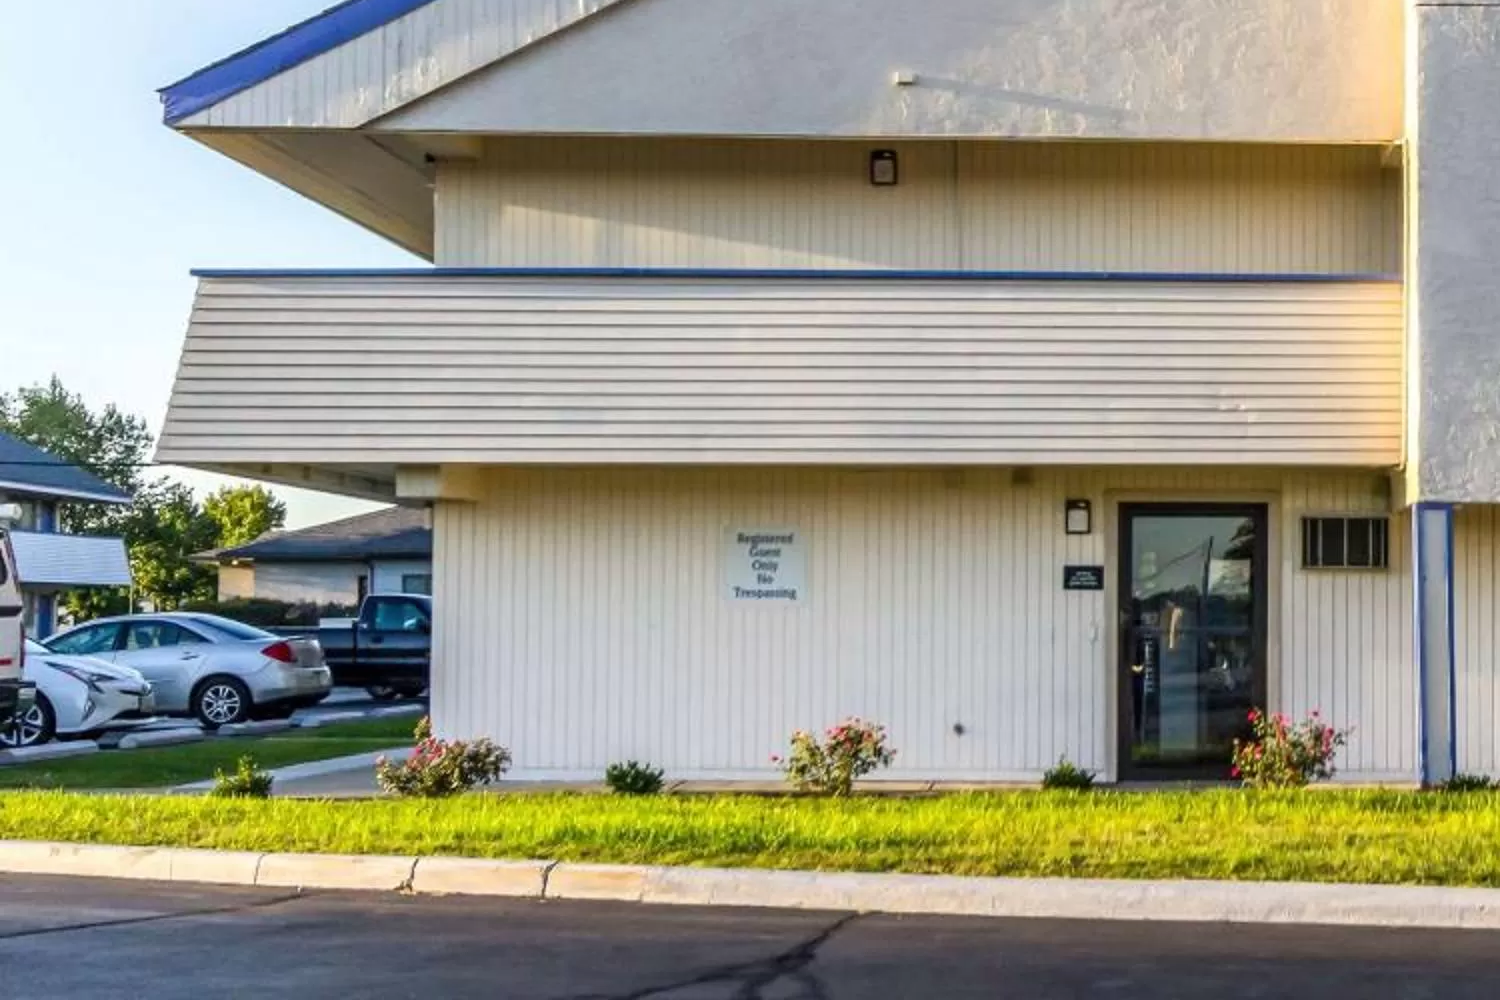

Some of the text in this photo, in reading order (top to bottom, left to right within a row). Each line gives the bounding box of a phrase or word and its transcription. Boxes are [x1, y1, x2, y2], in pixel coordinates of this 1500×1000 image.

[737, 532, 794, 548] Registered
[751, 560, 778, 572] Only
[757, 573, 774, 584] No
[733, 586, 797, 600] Trespassing
